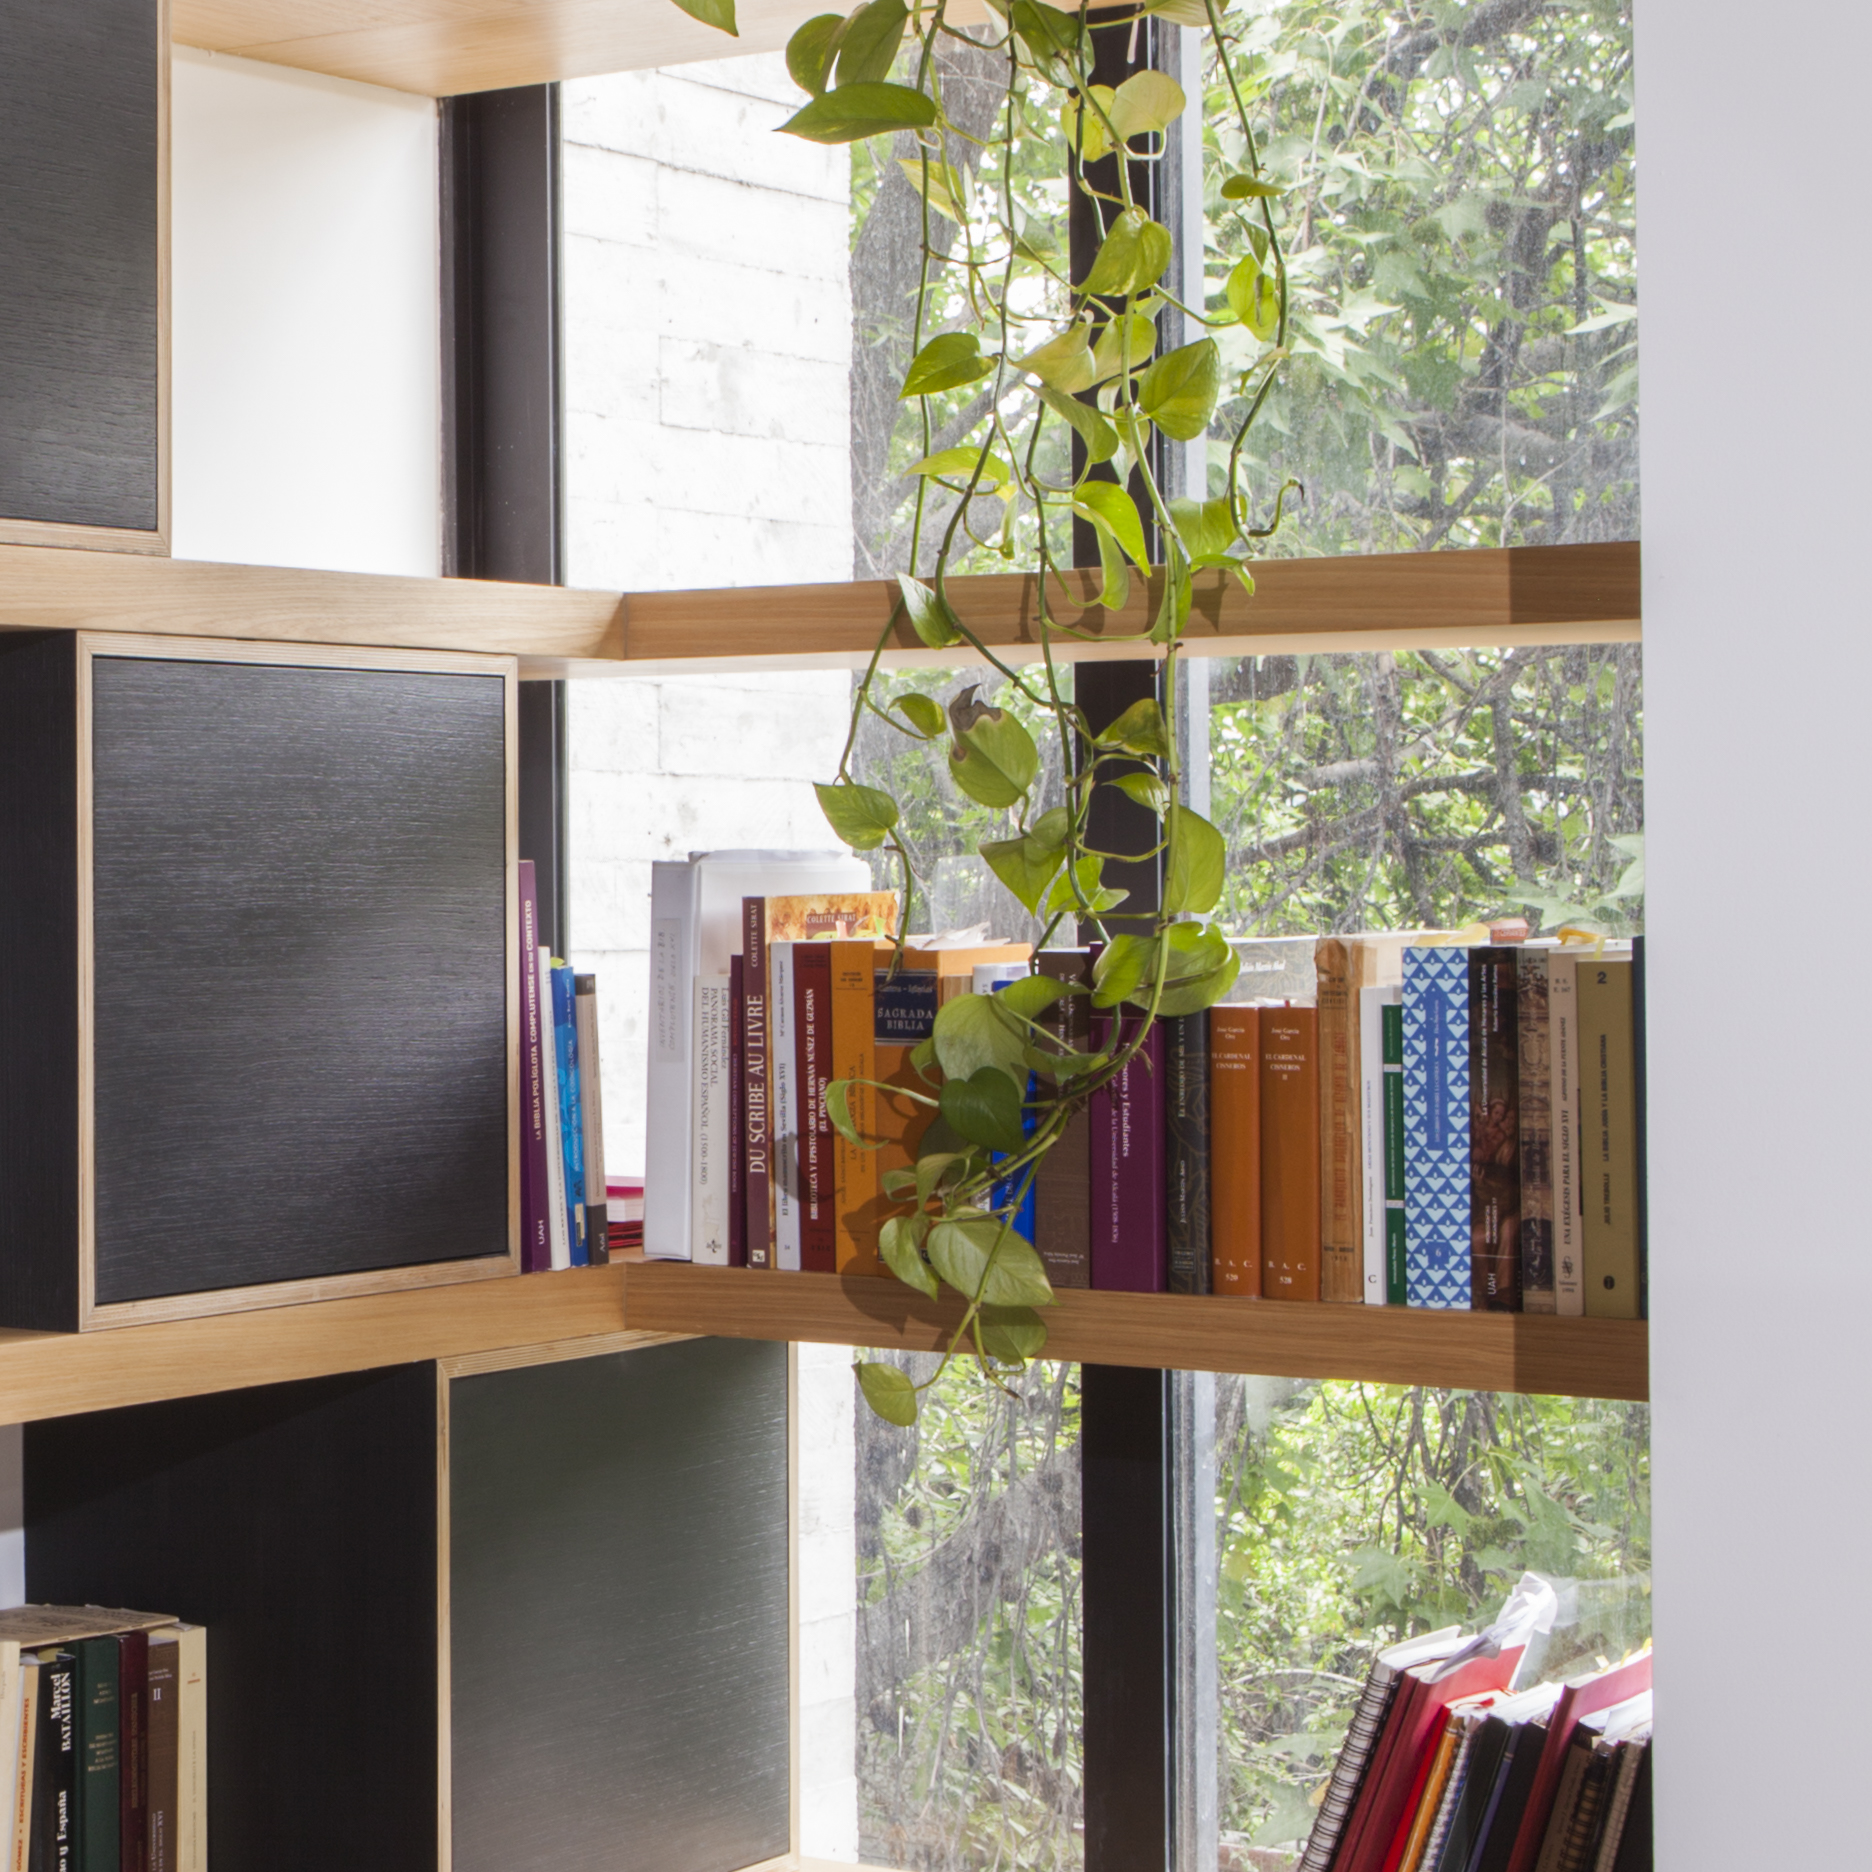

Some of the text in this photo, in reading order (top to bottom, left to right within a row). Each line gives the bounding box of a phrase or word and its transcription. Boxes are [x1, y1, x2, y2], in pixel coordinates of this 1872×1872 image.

[524, 900, 533, 950] CONTEXTO
[807, 913, 835, 925] COLETTE
[1597, 971, 1608, 985] 2
[527, 974, 537, 1042] COMPLUTENSE
[804, 988, 814, 1021] GUZMÁN
[876, 1007, 934, 1020] SAGRADA
[709, 987, 718, 1087] PANORAMA SOCIAL
[719, 987, 730, 1069] Luis Gil Fernández
[806, 1023, 814, 1034] DE
[886, 1019, 924, 1032] BIBLIA
[805, 1036, 815, 1061] NÚÑEZ
[1220, 1053, 1252, 1061] CARDENAL
[1273, 1054, 1306, 1062] CARDENAL
[1599, 1033, 1607, 1068] CRISTIANA
[529, 1044, 539, 1096] POLÍGLOTA
[1215, 1062, 1246, 1070] CISNEROS
[1270, 1063, 1301, 1071] CISNEROS
[698, 986, 709, 1185] DEL HUMANISMO ESPAÑOL (1500-1800)
[746, 994, 765, 1173] DU SCRIBE AU LIVRE
[805, 1064, 815, 1096] HERNÁN
[808, 1098, 815, 1109] DE
[817, 1076, 827, 1131] (EL PINCIANO)
[1601, 1092, 1607, 1101] LA
[532, 1098, 540, 1128] BIBLIA
[1600, 1109, 1608, 1126] JUDÍA
[535, 1129, 541, 1140] LA
[808, 1111, 816, 1163] EPISTOLARIO
[1561, 1125, 1569, 1150] SIGLO
[1562, 1151, 1569, 1162] EL
[1602, 1152, 1609, 1161] LA
[809, 1172, 818, 1219] BIBLIOTECA
[1561, 1186, 1570, 1226] EXÉGESIS
[1435, 1248, 1442, 1258] 6
[1368, 1274, 1376, 1284] C
[1488, 1273, 1496, 1296] UAH
[50, 1672, 61, 1720] Marcel
[60, 1671, 71, 1751] BATAILLON
[20, 1697, 30, 1758] ESCRIBIENTES
[17, 1769, 26, 1823] ESCRITURAS
[56, 1790, 68, 1840] España
[15, 1838, 23, 1871] GÓMEZ
[58, 1845, 68, 1855] y
